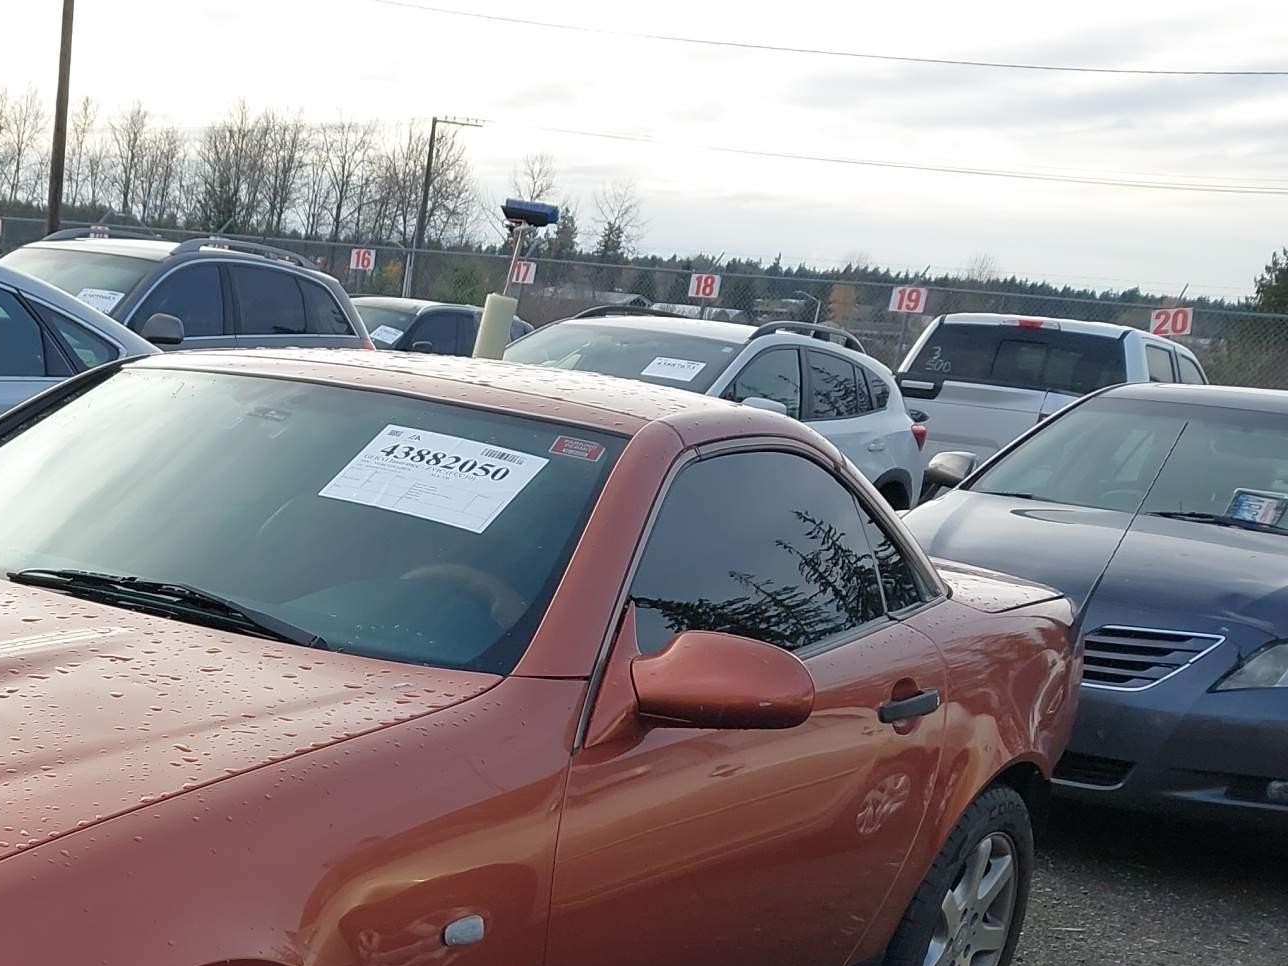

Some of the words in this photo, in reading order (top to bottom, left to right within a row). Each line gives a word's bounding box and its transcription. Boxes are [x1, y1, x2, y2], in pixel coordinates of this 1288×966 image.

[354, 249, 372, 269] 16
[514, 263, 532, 282] 17
[695, 275, 716, 297] 18
[896, 288, 921, 311] 19
[1152, 309, 1189, 336] 20
[380, 443, 511, 482] 43882050
